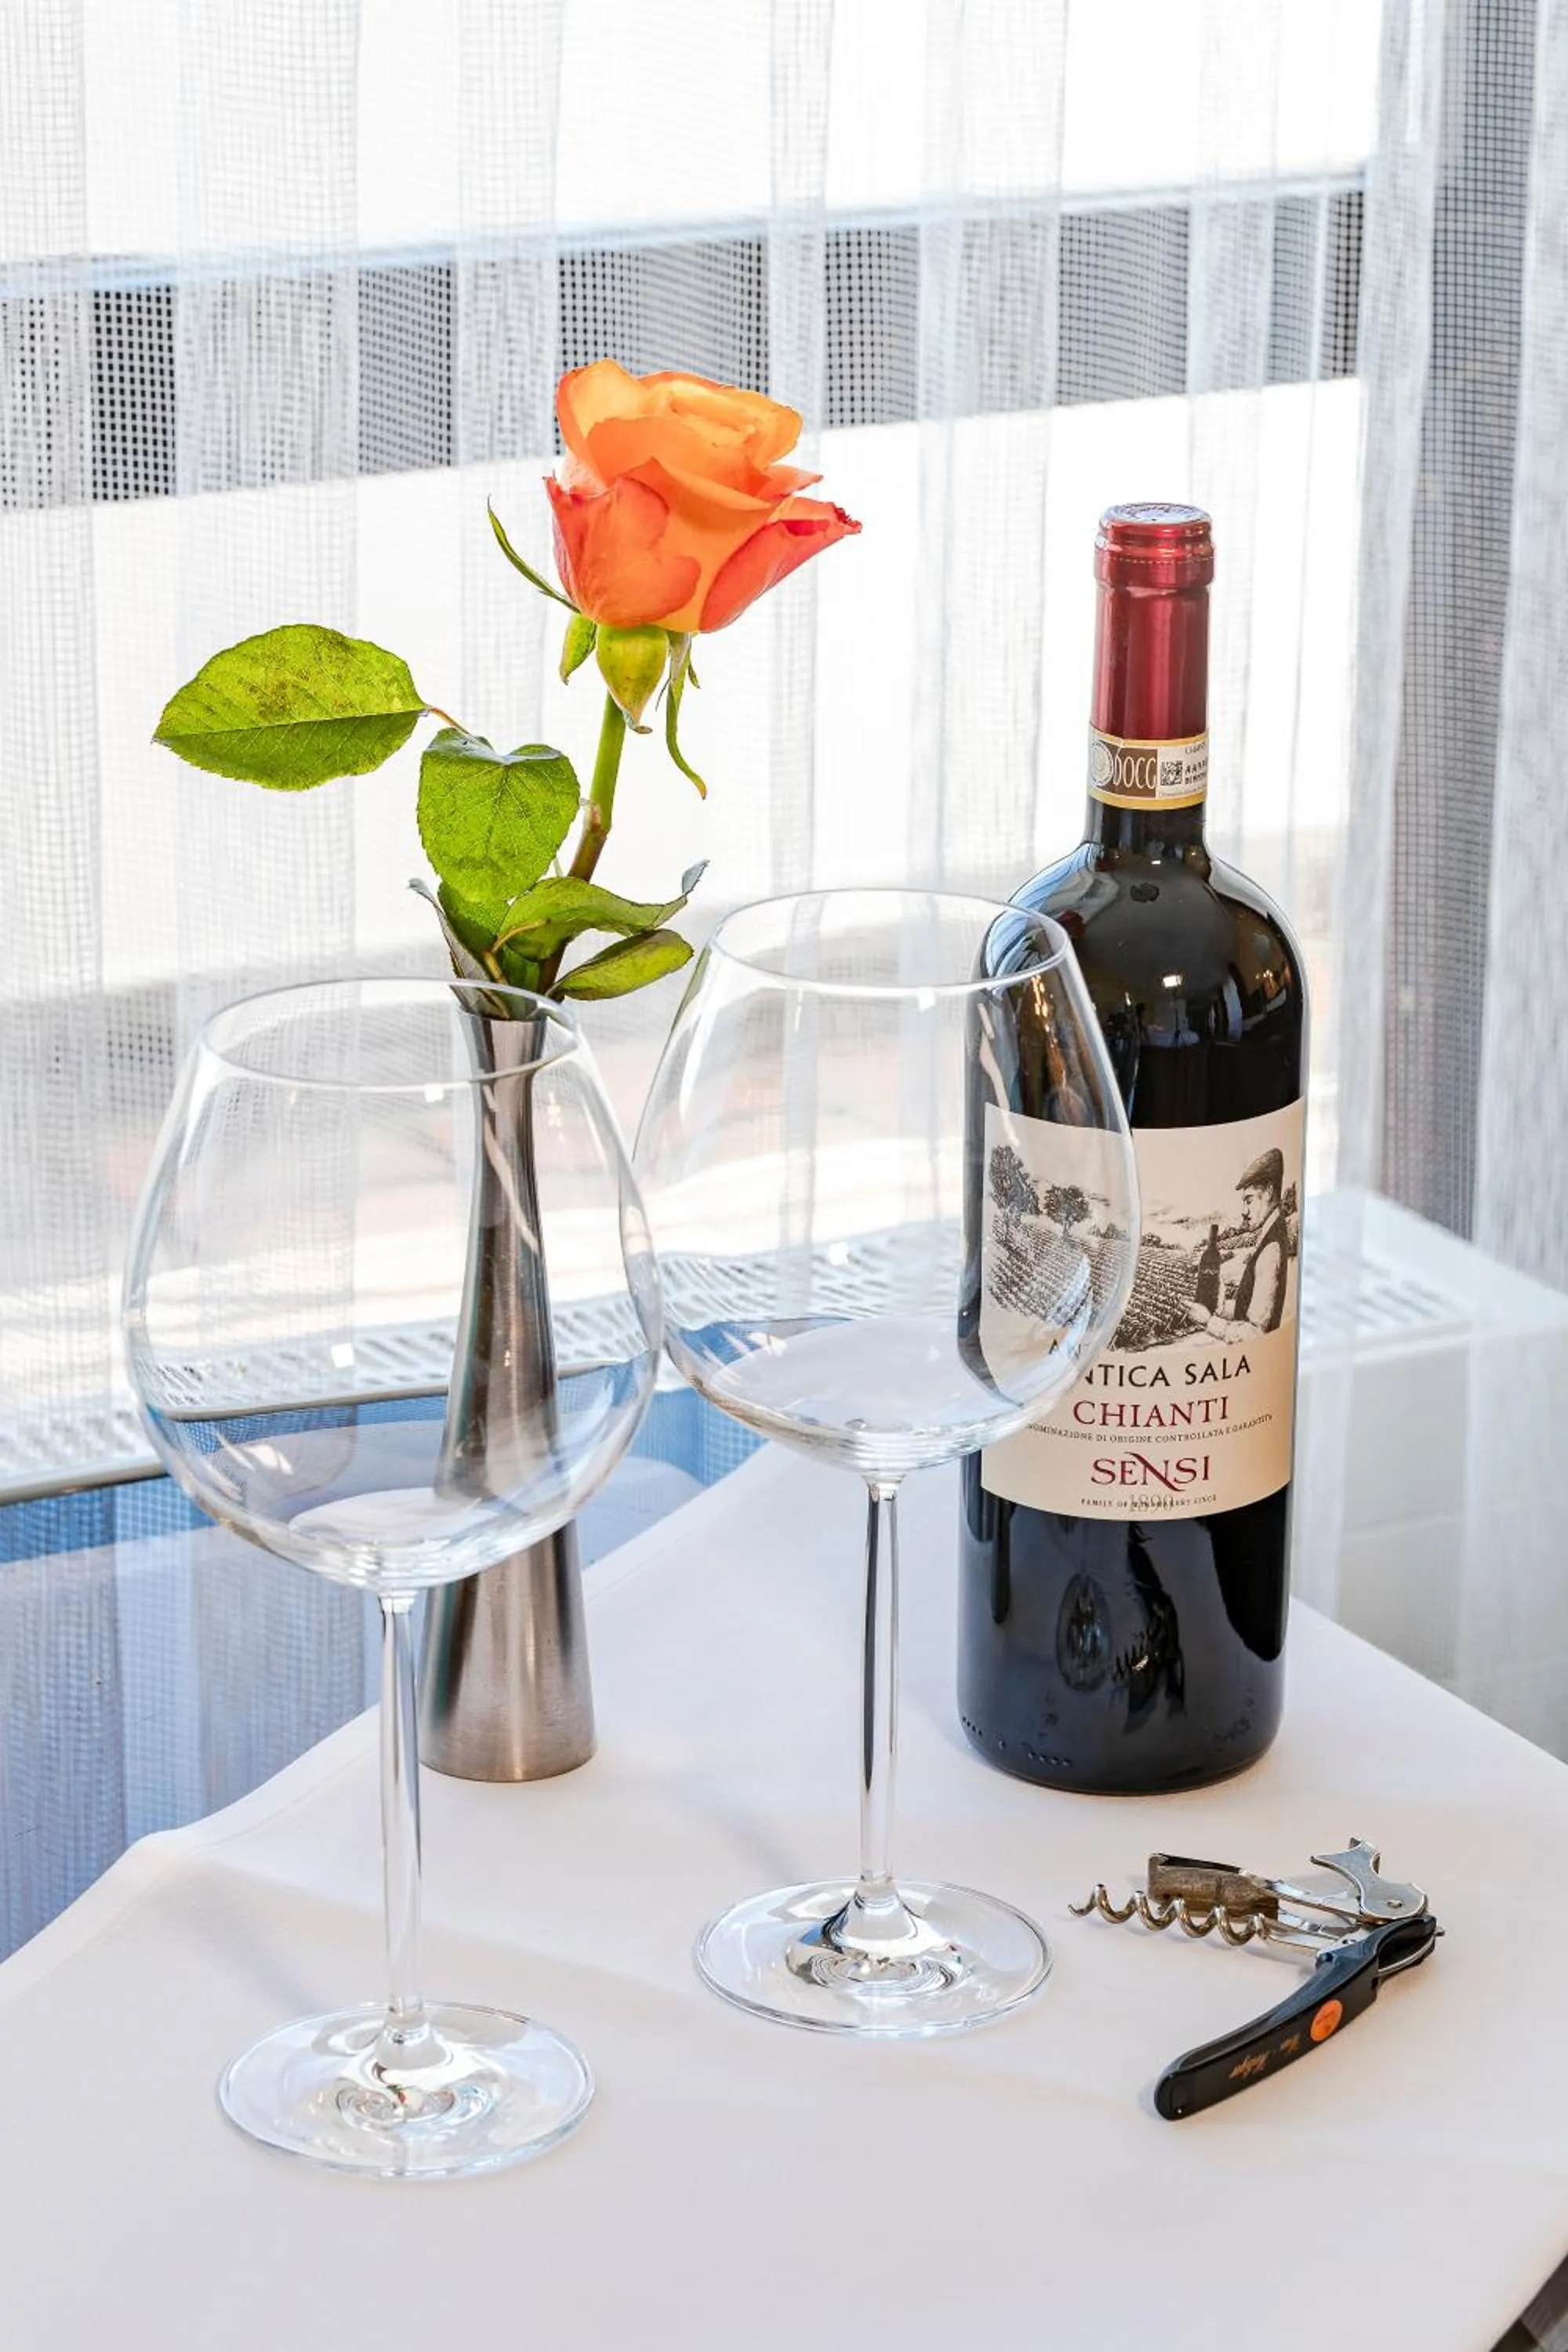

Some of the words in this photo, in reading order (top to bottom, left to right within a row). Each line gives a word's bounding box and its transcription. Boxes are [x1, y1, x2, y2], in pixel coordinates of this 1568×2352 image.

[1113, 749, 1156, 789] DOCG
[1085, 1363, 1171, 1387] TICA
[1185, 1355, 1251, 1386] SALA
[1073, 1396, 1229, 1428] CHIANTI
[1109, 1435, 1152, 1443] ORIGINE
[1155, 1428, 1224, 1443] CONTROLLATA
[1091, 1451, 1210, 1491] SENSI
